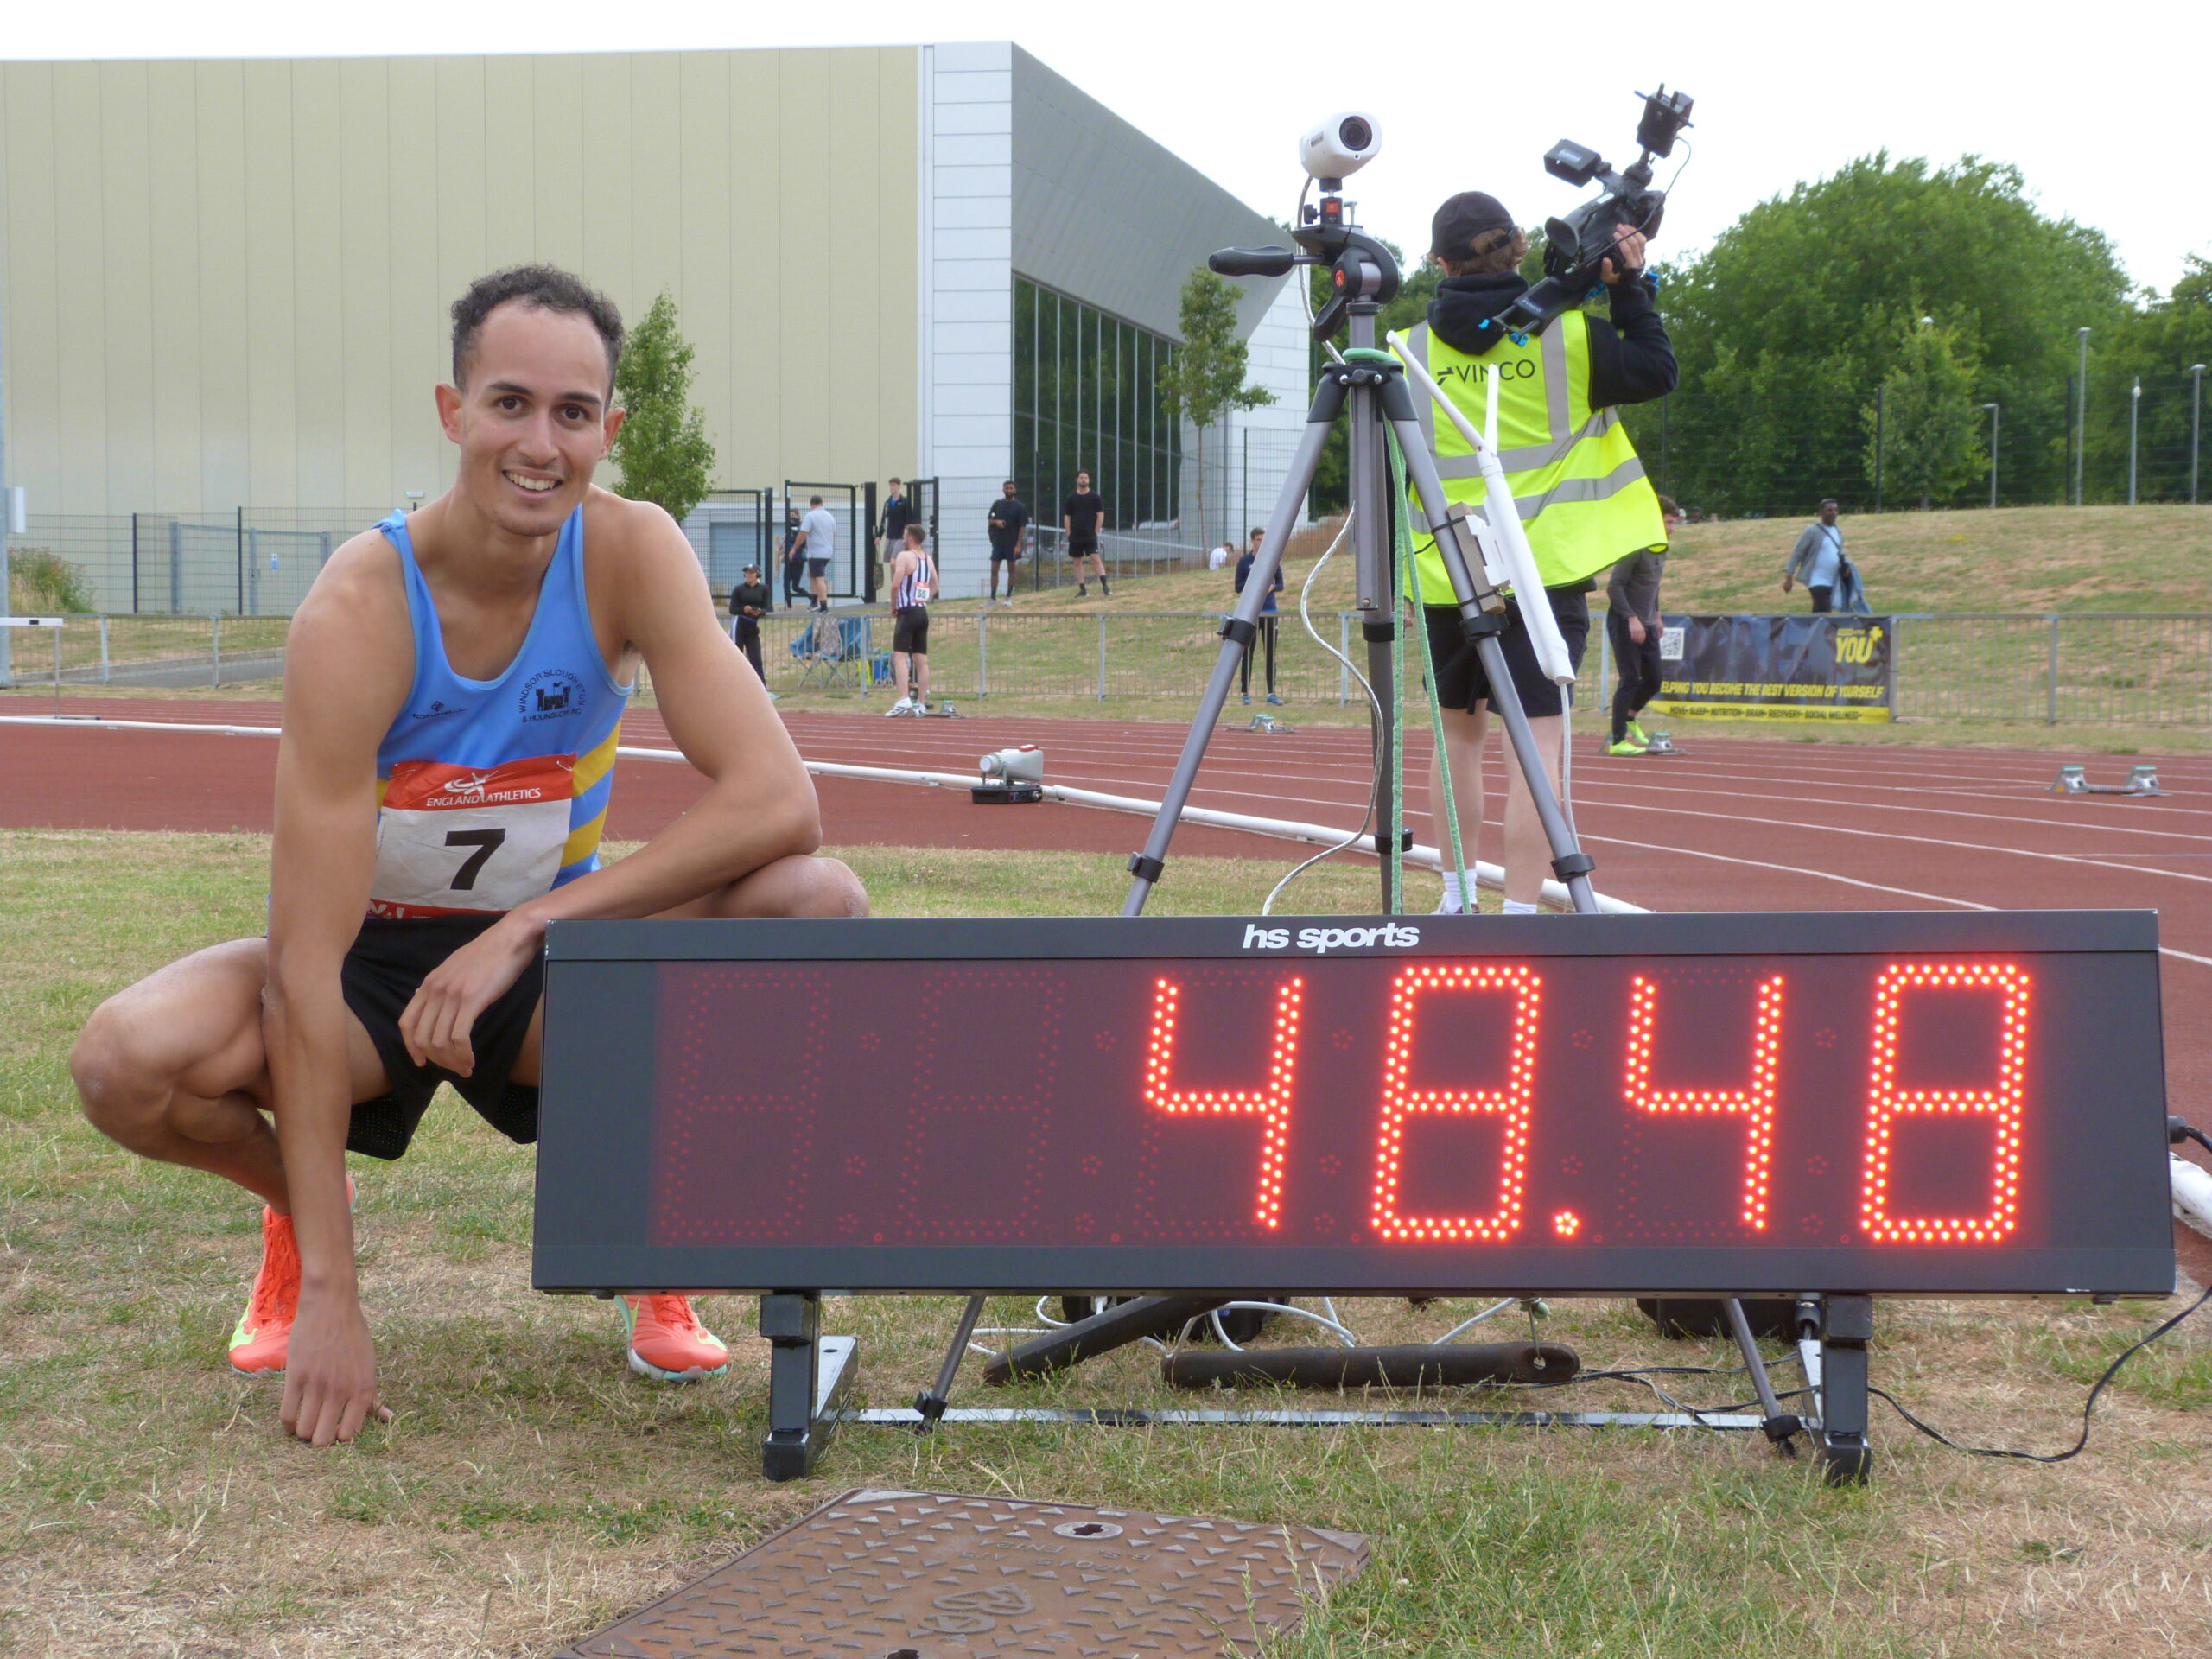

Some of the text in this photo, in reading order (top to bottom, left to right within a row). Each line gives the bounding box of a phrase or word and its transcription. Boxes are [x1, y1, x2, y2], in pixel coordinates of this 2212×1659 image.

[1456, 359, 1535, 384] VINCO
[518, 673, 543, 714] WINDSOR
[543, 669, 578, 684] SLOUGH
[1660, 680, 1885, 699] ELPING YOU BECOME THE BEST VERSION OF YOURSELF
[427, 788, 541, 807] ENGLAND ATHLETICS
[445, 828, 506, 891] 7
[1243, 922, 1420, 954] hs sports
[1145, 964, 2030, 1243] 48.48
